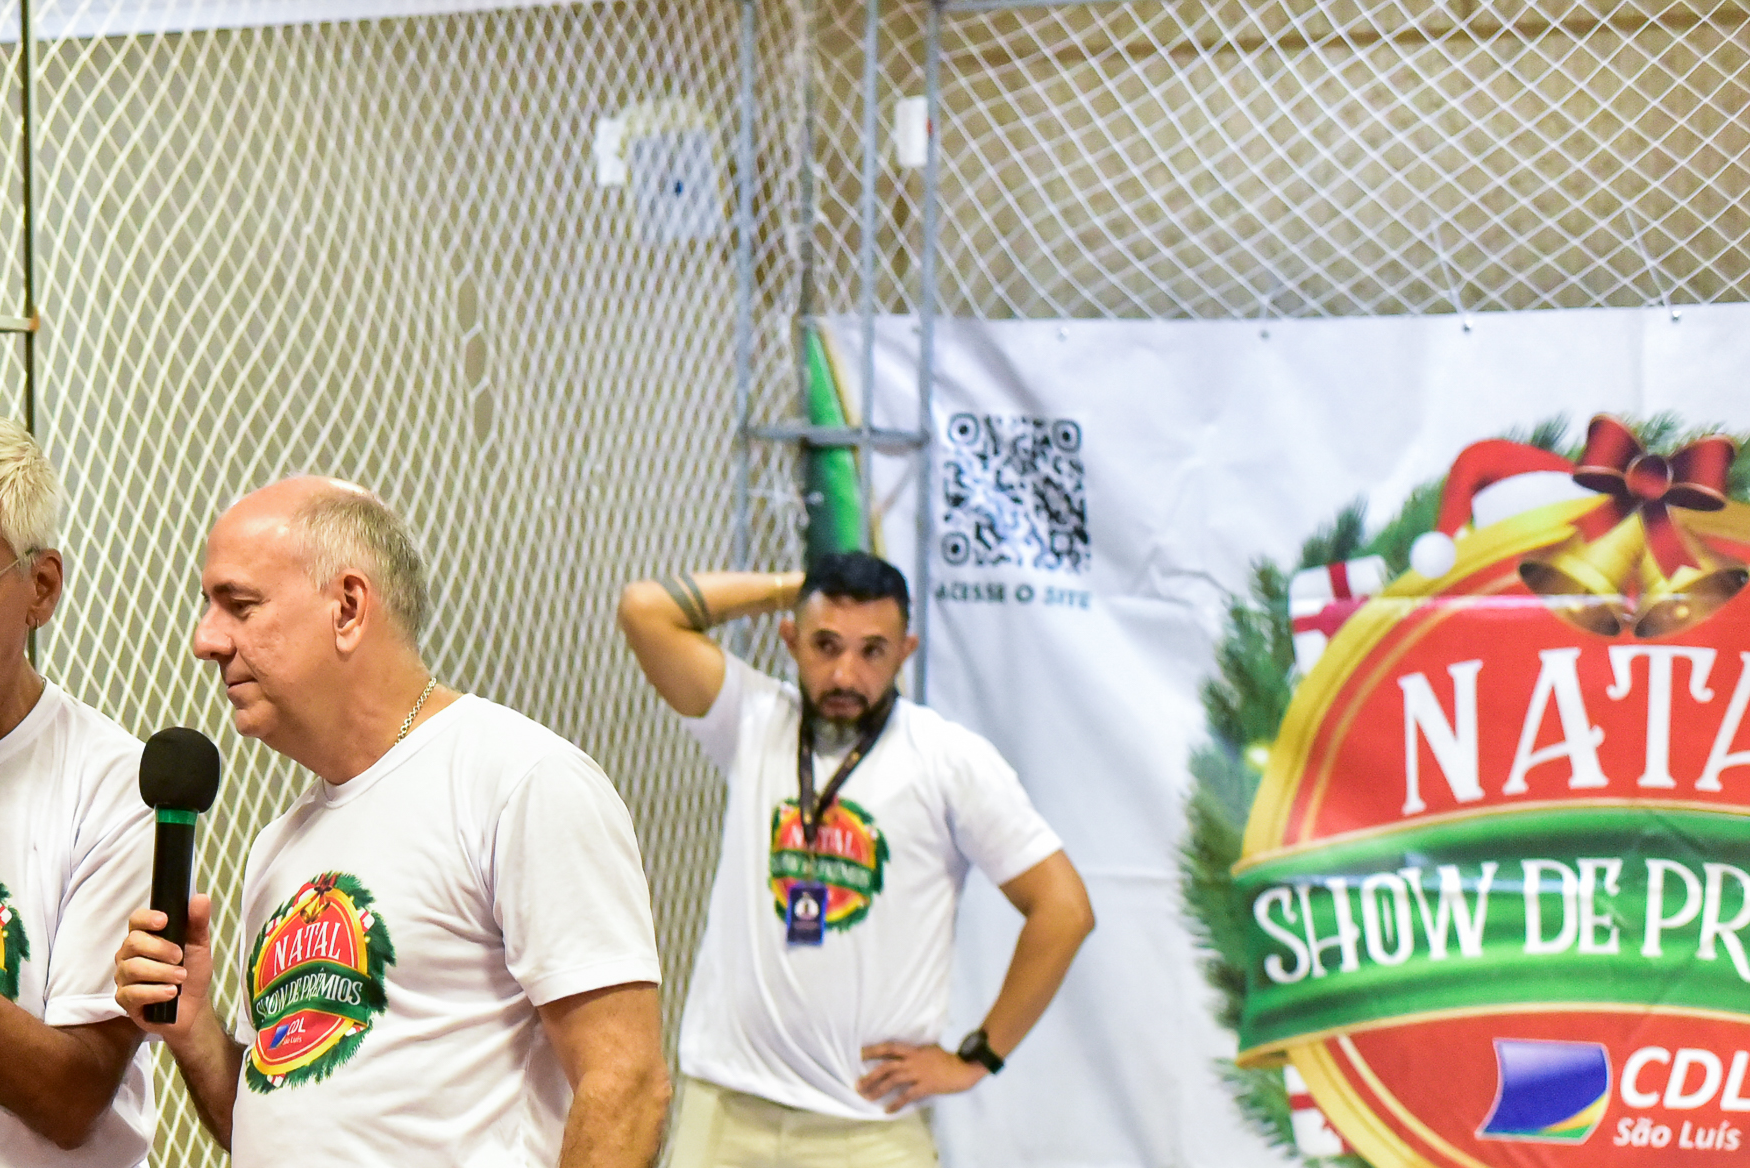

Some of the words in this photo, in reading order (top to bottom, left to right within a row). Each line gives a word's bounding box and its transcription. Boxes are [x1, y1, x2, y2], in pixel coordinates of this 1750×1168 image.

[787, 823, 857, 860] NTAL
[1253, 862, 1499, 984] SHOW
[1521, 858, 1623, 955] DE
[273, 921, 341, 977] NATAL
[300, 967, 364, 1006] PRÊMIOS
[1620, 1046, 1750, 1111] CDL
[1613, 1117, 1672, 1149] São
[1678, 1119, 1742, 1152] Luís
